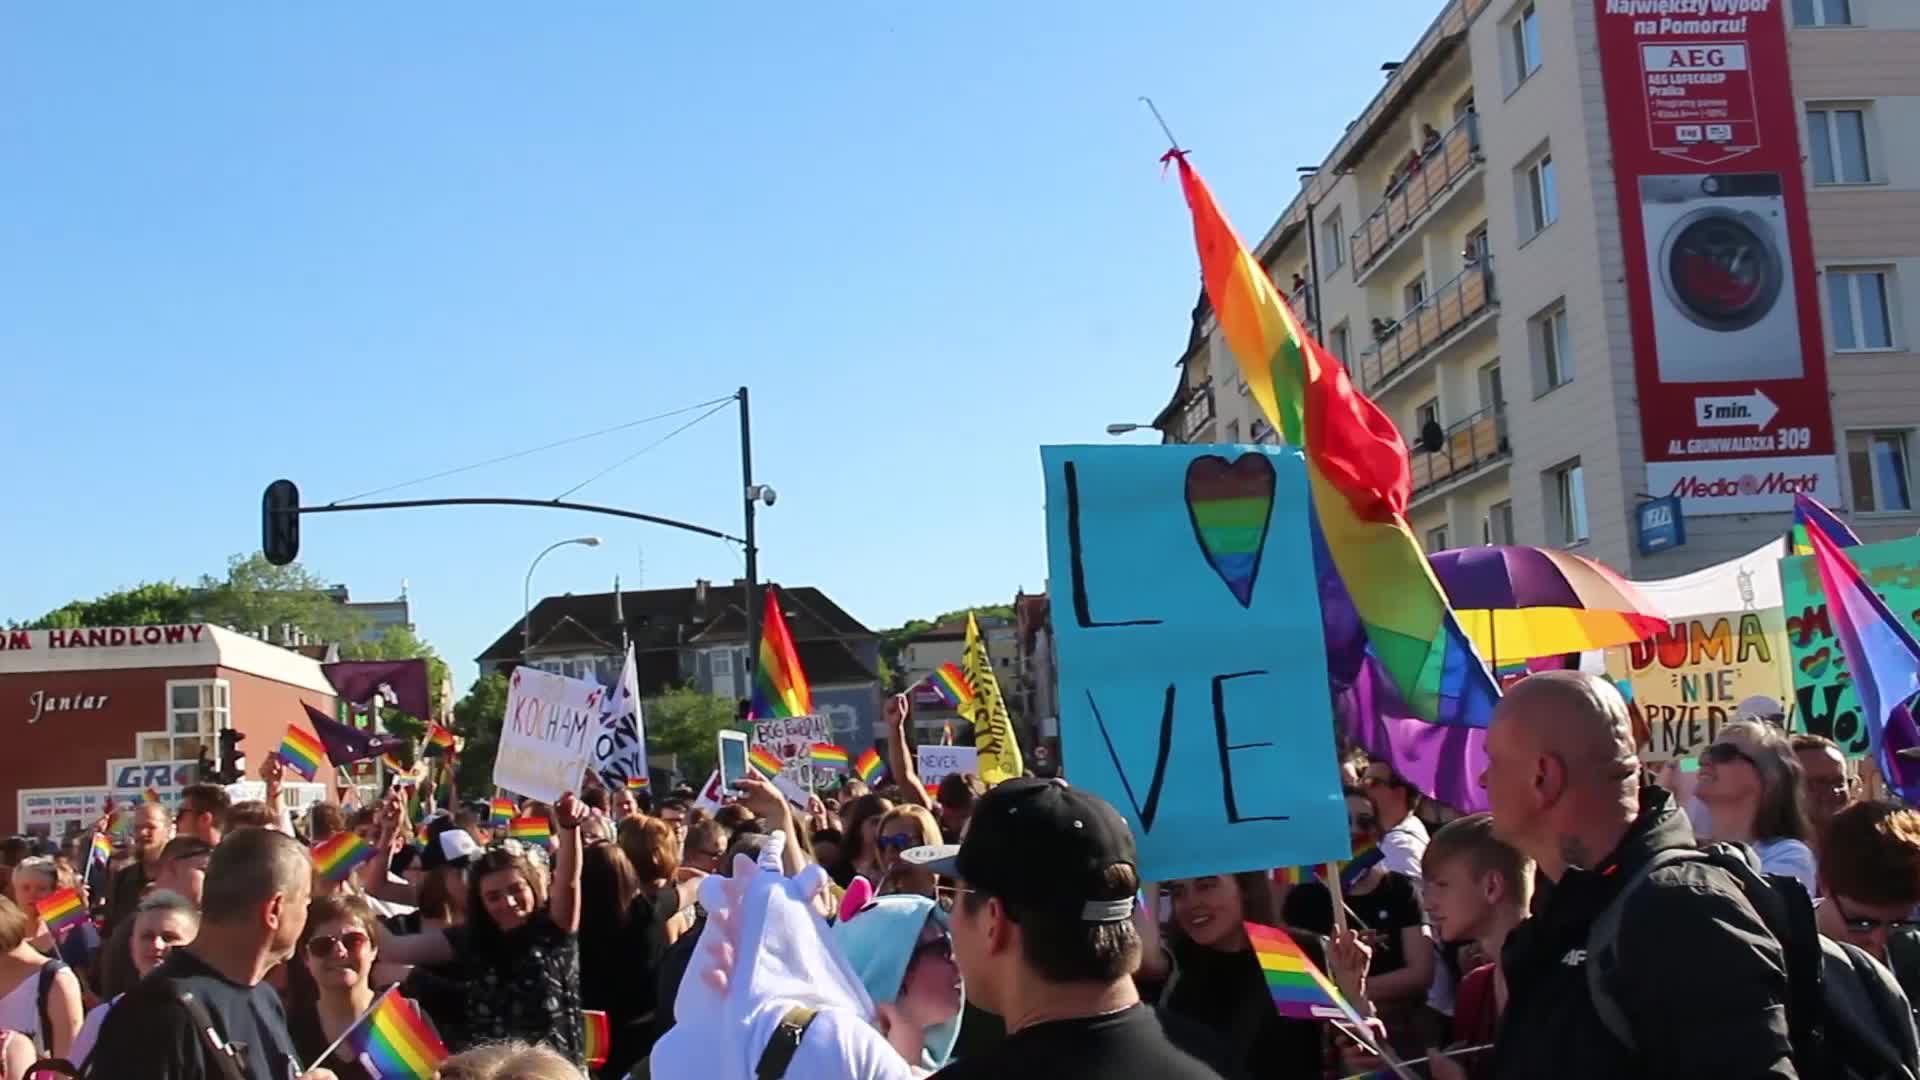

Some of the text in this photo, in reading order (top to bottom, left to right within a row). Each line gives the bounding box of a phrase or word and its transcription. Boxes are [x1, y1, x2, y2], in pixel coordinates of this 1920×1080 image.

[1634, 16, 1748, 35] na Pomorzu!
[1667, 49, 1725, 68] AEG
[1703, 402, 1752, 420] 5 min.
[1668, 428, 1811, 455] AL. GRUNWALDZKA 309
[1671, 472, 1819, 498] Media Markt
[49, 624, 204, 649] HANDLOWY
[1628, 613, 1772, 670] DUMA
[27, 690, 108, 723] Jantar
[512, 696, 589, 754] KOCHAM
[920, 754, 960, 769] NEVER
[1561, 949, 1588, 966] 4F
